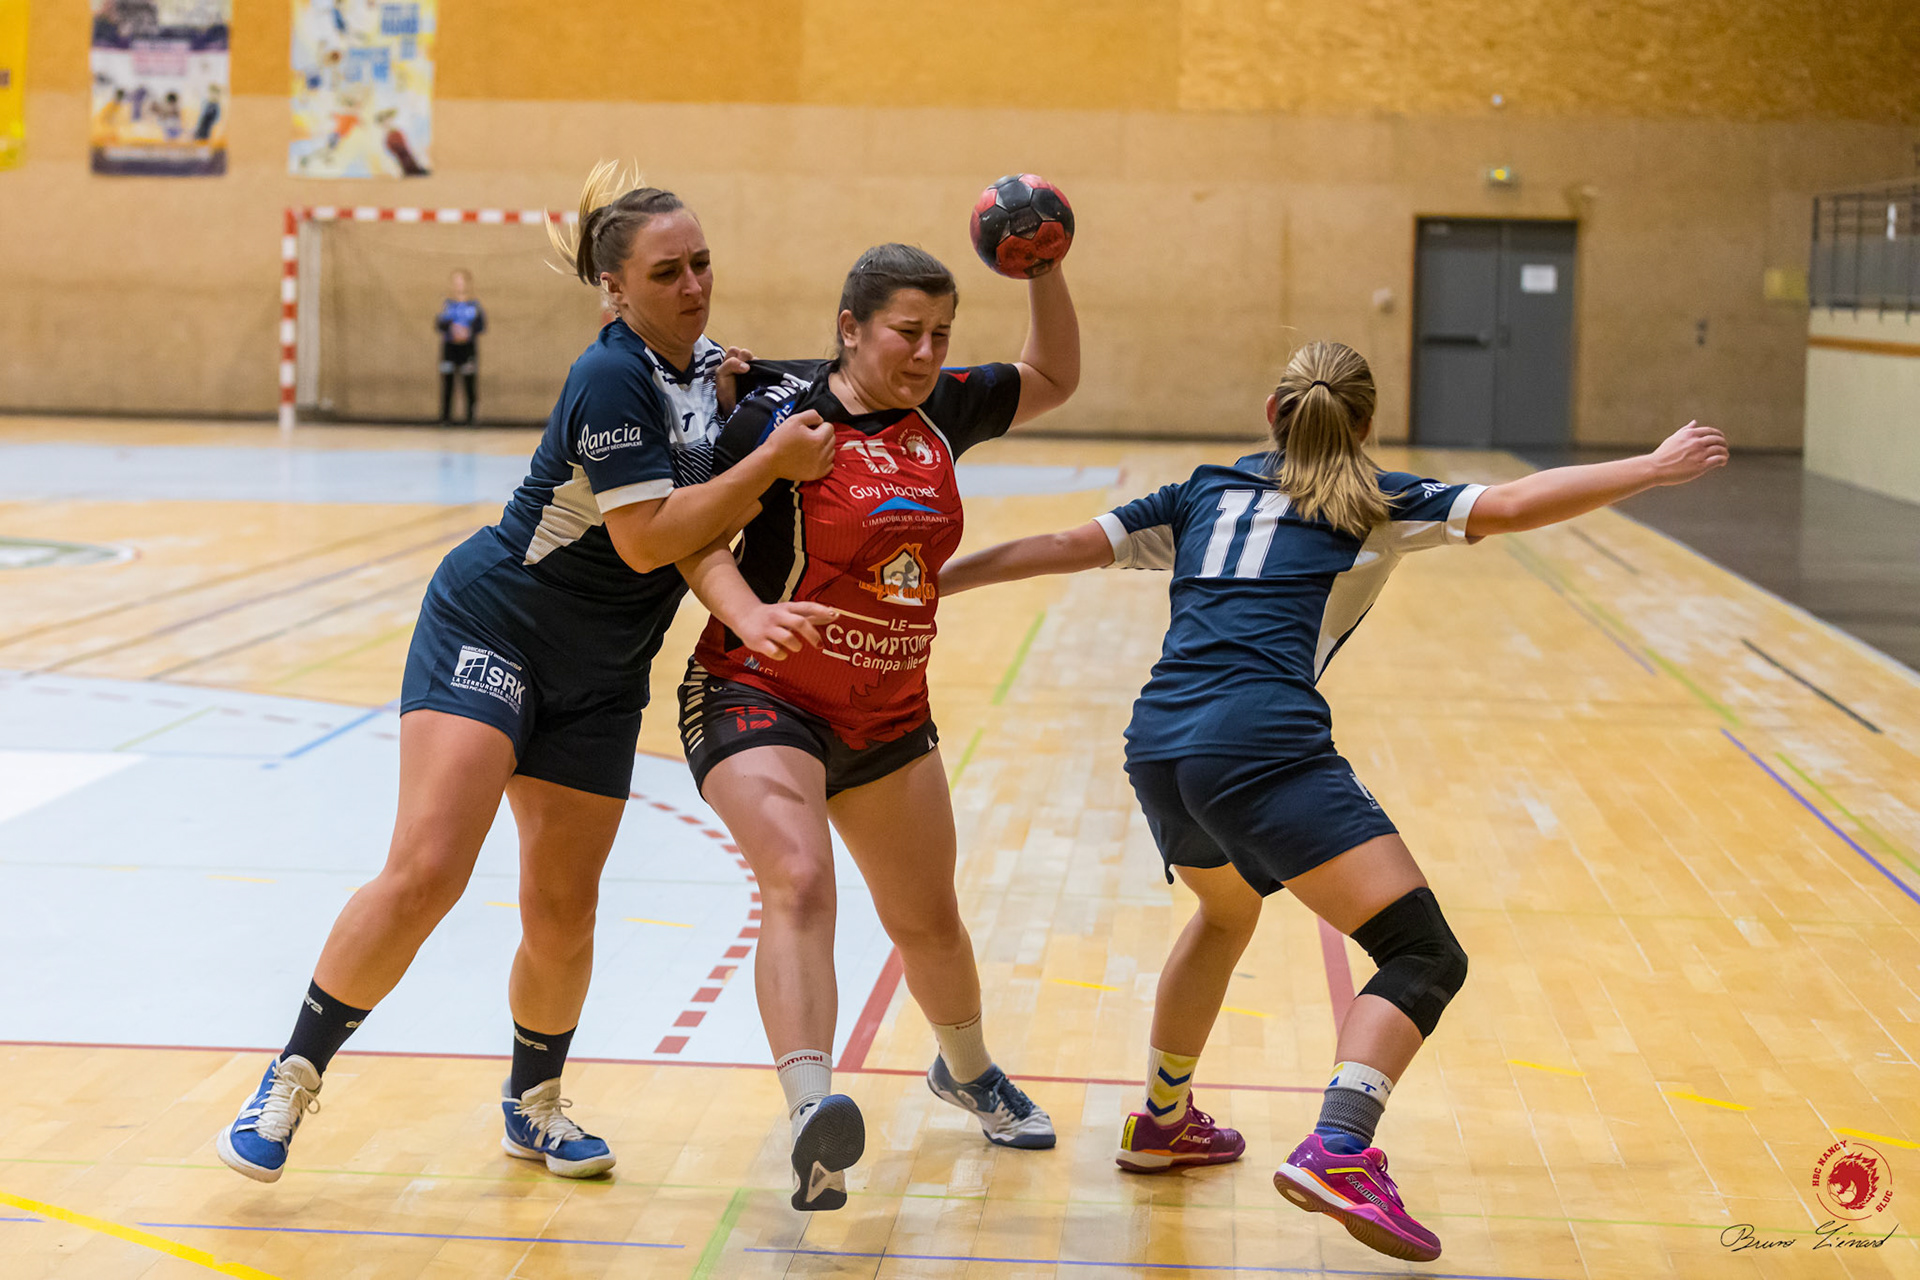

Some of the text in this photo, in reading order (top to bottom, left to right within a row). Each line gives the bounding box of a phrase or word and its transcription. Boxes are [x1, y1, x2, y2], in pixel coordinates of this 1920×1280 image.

[849, 485, 881, 499] Guy
[1195, 489, 1291, 578] 11
[890, 618, 908, 631] LE
[851, 652, 918, 675] Campanile
[486, 666, 526, 705] SRK
[777, 1055, 823, 1072] hummel
[1345, 1174, 1389, 1212] SALMING
